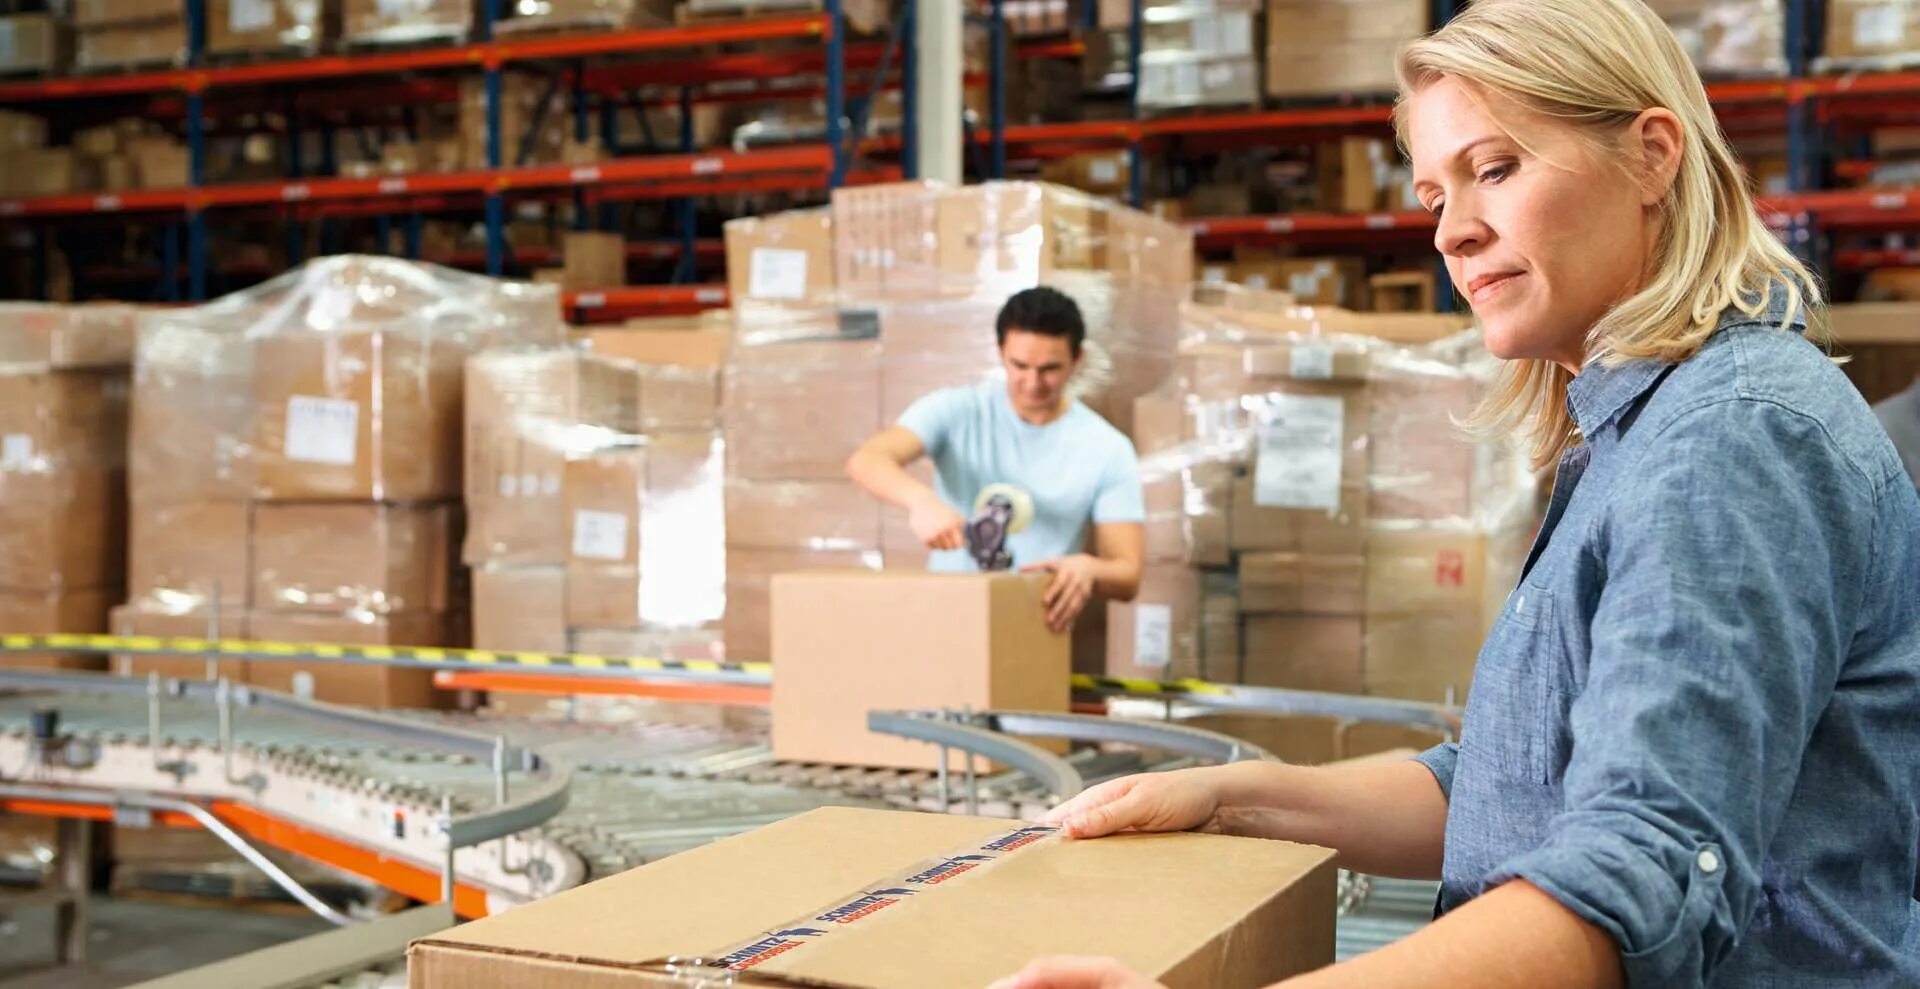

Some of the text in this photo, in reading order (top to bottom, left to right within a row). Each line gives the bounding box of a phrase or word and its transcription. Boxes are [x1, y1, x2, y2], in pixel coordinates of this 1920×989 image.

[905, 861, 964, 884] SCHMITZ
[816, 895, 883, 922] SCHMITZ
[708, 937, 788, 968] SCHMITZ
[727, 941, 806, 971] CARGOBULL
